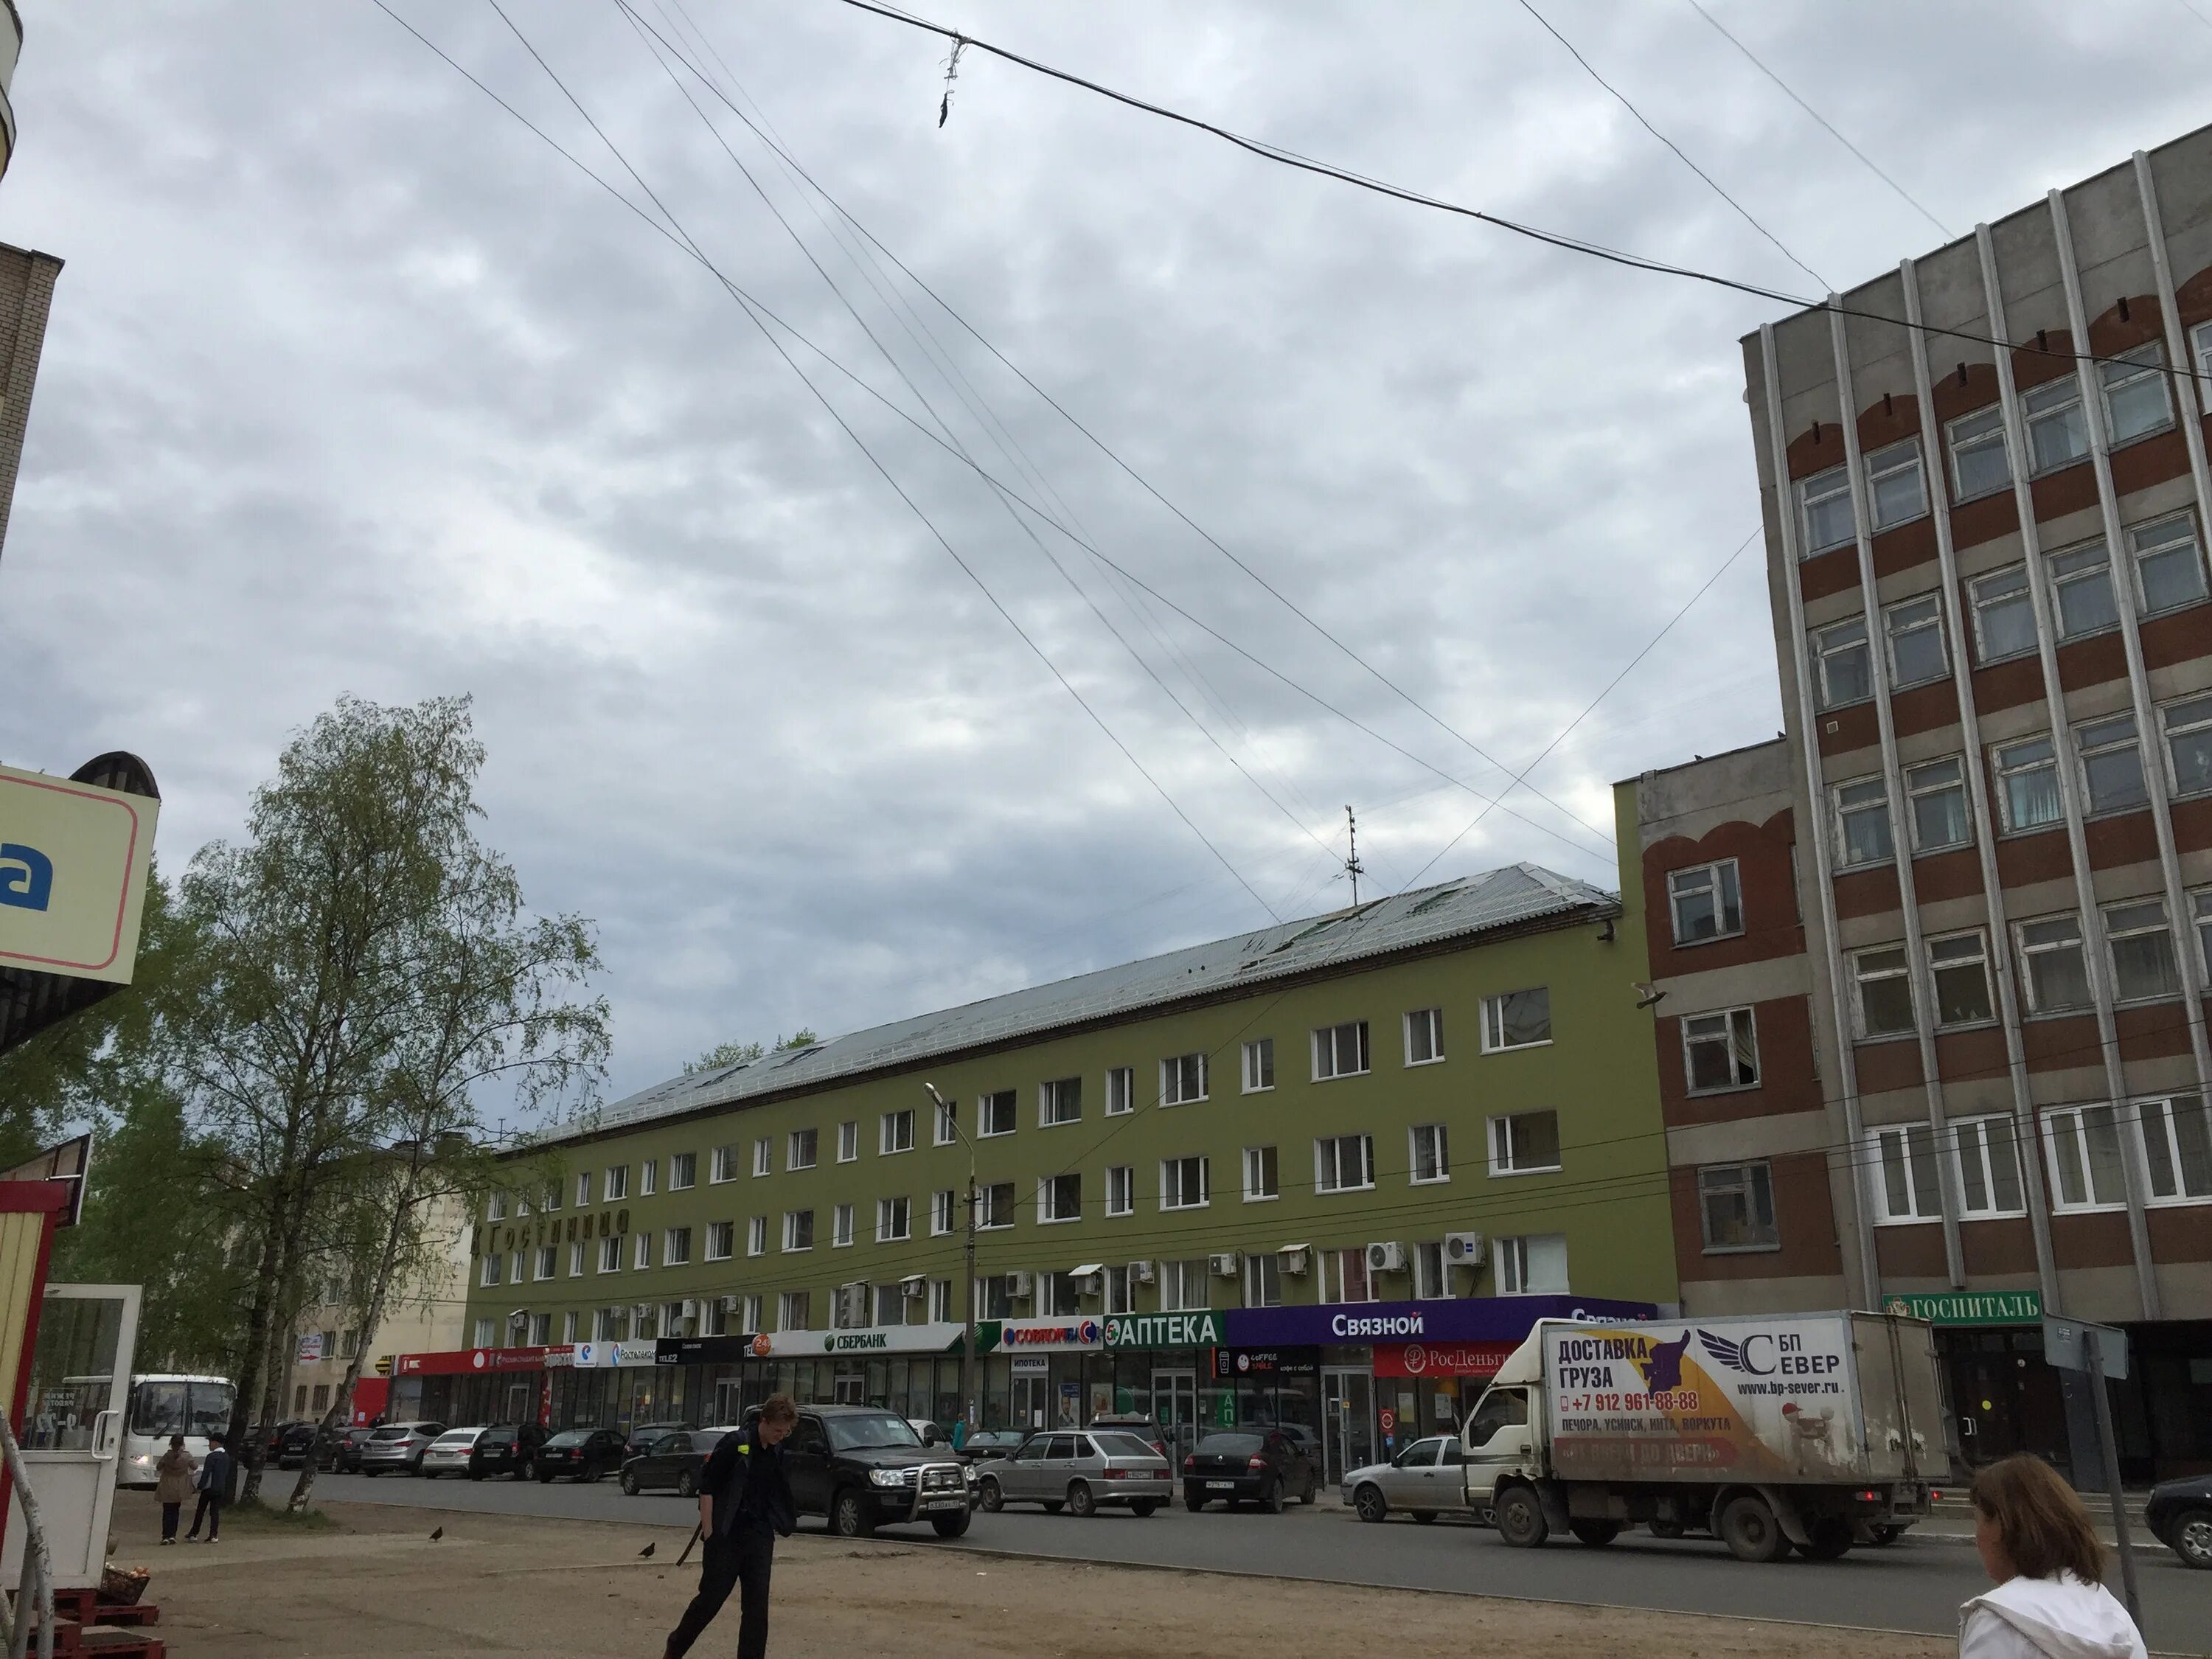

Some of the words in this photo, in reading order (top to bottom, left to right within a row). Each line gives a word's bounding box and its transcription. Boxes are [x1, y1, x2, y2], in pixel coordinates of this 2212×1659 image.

[1911, 1295, 2039, 1318] ГОСПИТАЛЬ
[1119, 1315, 1218, 1346] АПТЕКА
[1332, 1311, 1425, 1337] Связной
[837, 1333, 887, 1349] СБЕРБАНК
[1778, 1334, 1801, 1352] БП
[658, 1353, 678, 1363] TELE2
[1559, 1338, 1649, 1364] ДОСТАВКА
[1014, 1359, 1046, 1367] ИПОТЕКА
[1559, 1366, 1613, 1388] ГРУЗА
[1738, 1381, 1839, 1397] www.bp-sever.ru
[1572, 1394, 1591, 1411] +7
[1596, 1394, 1620, 1411] 912
[1624, 1391, 1699, 1411] 961-88-88
[1562, 1418, 1601, 1432] ПЕЧОРА,
[1682, 1416, 1731, 1430] ВОРКУТА
